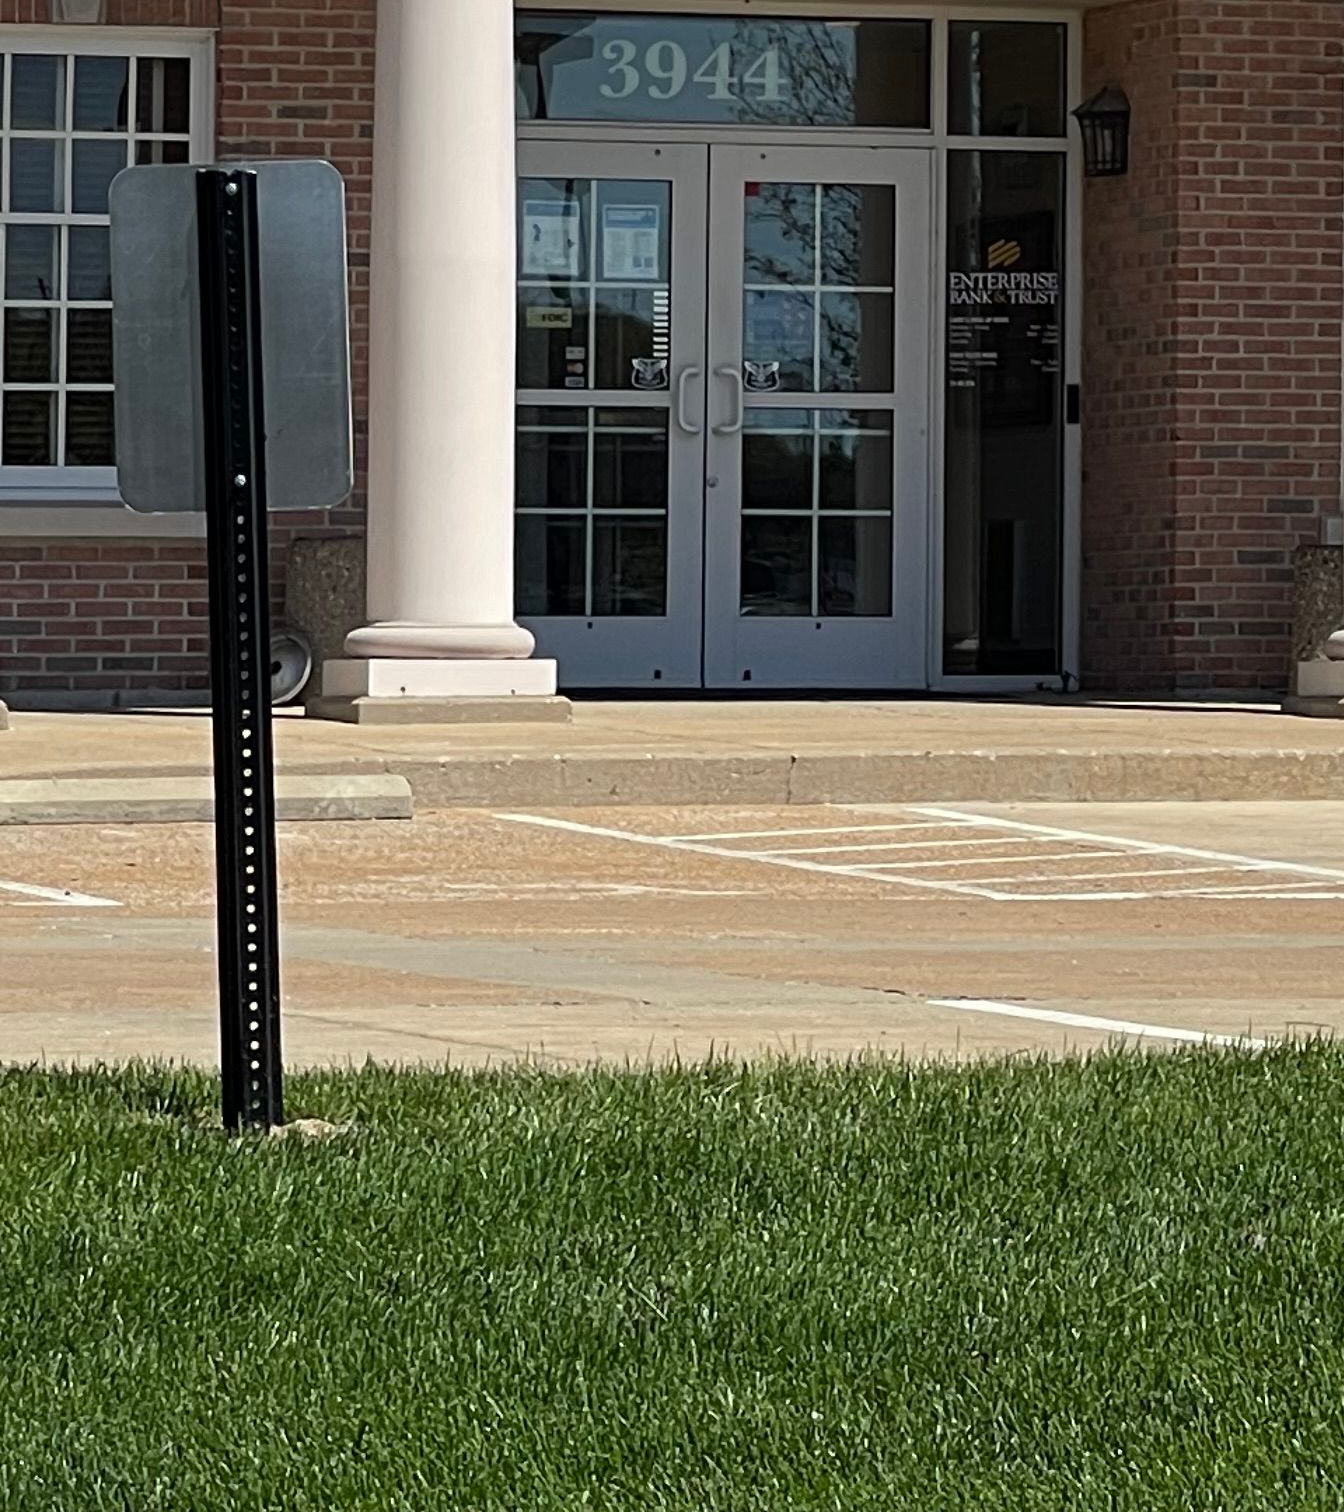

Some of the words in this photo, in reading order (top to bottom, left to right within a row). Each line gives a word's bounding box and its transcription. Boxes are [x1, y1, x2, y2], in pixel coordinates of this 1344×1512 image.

[600, 39, 792, 102] 3944
[949, 272, 1059, 289] ENTERPRISE
[949, 290, 993, 305] BANK
[1007, 290, 1060, 305] TRUST
